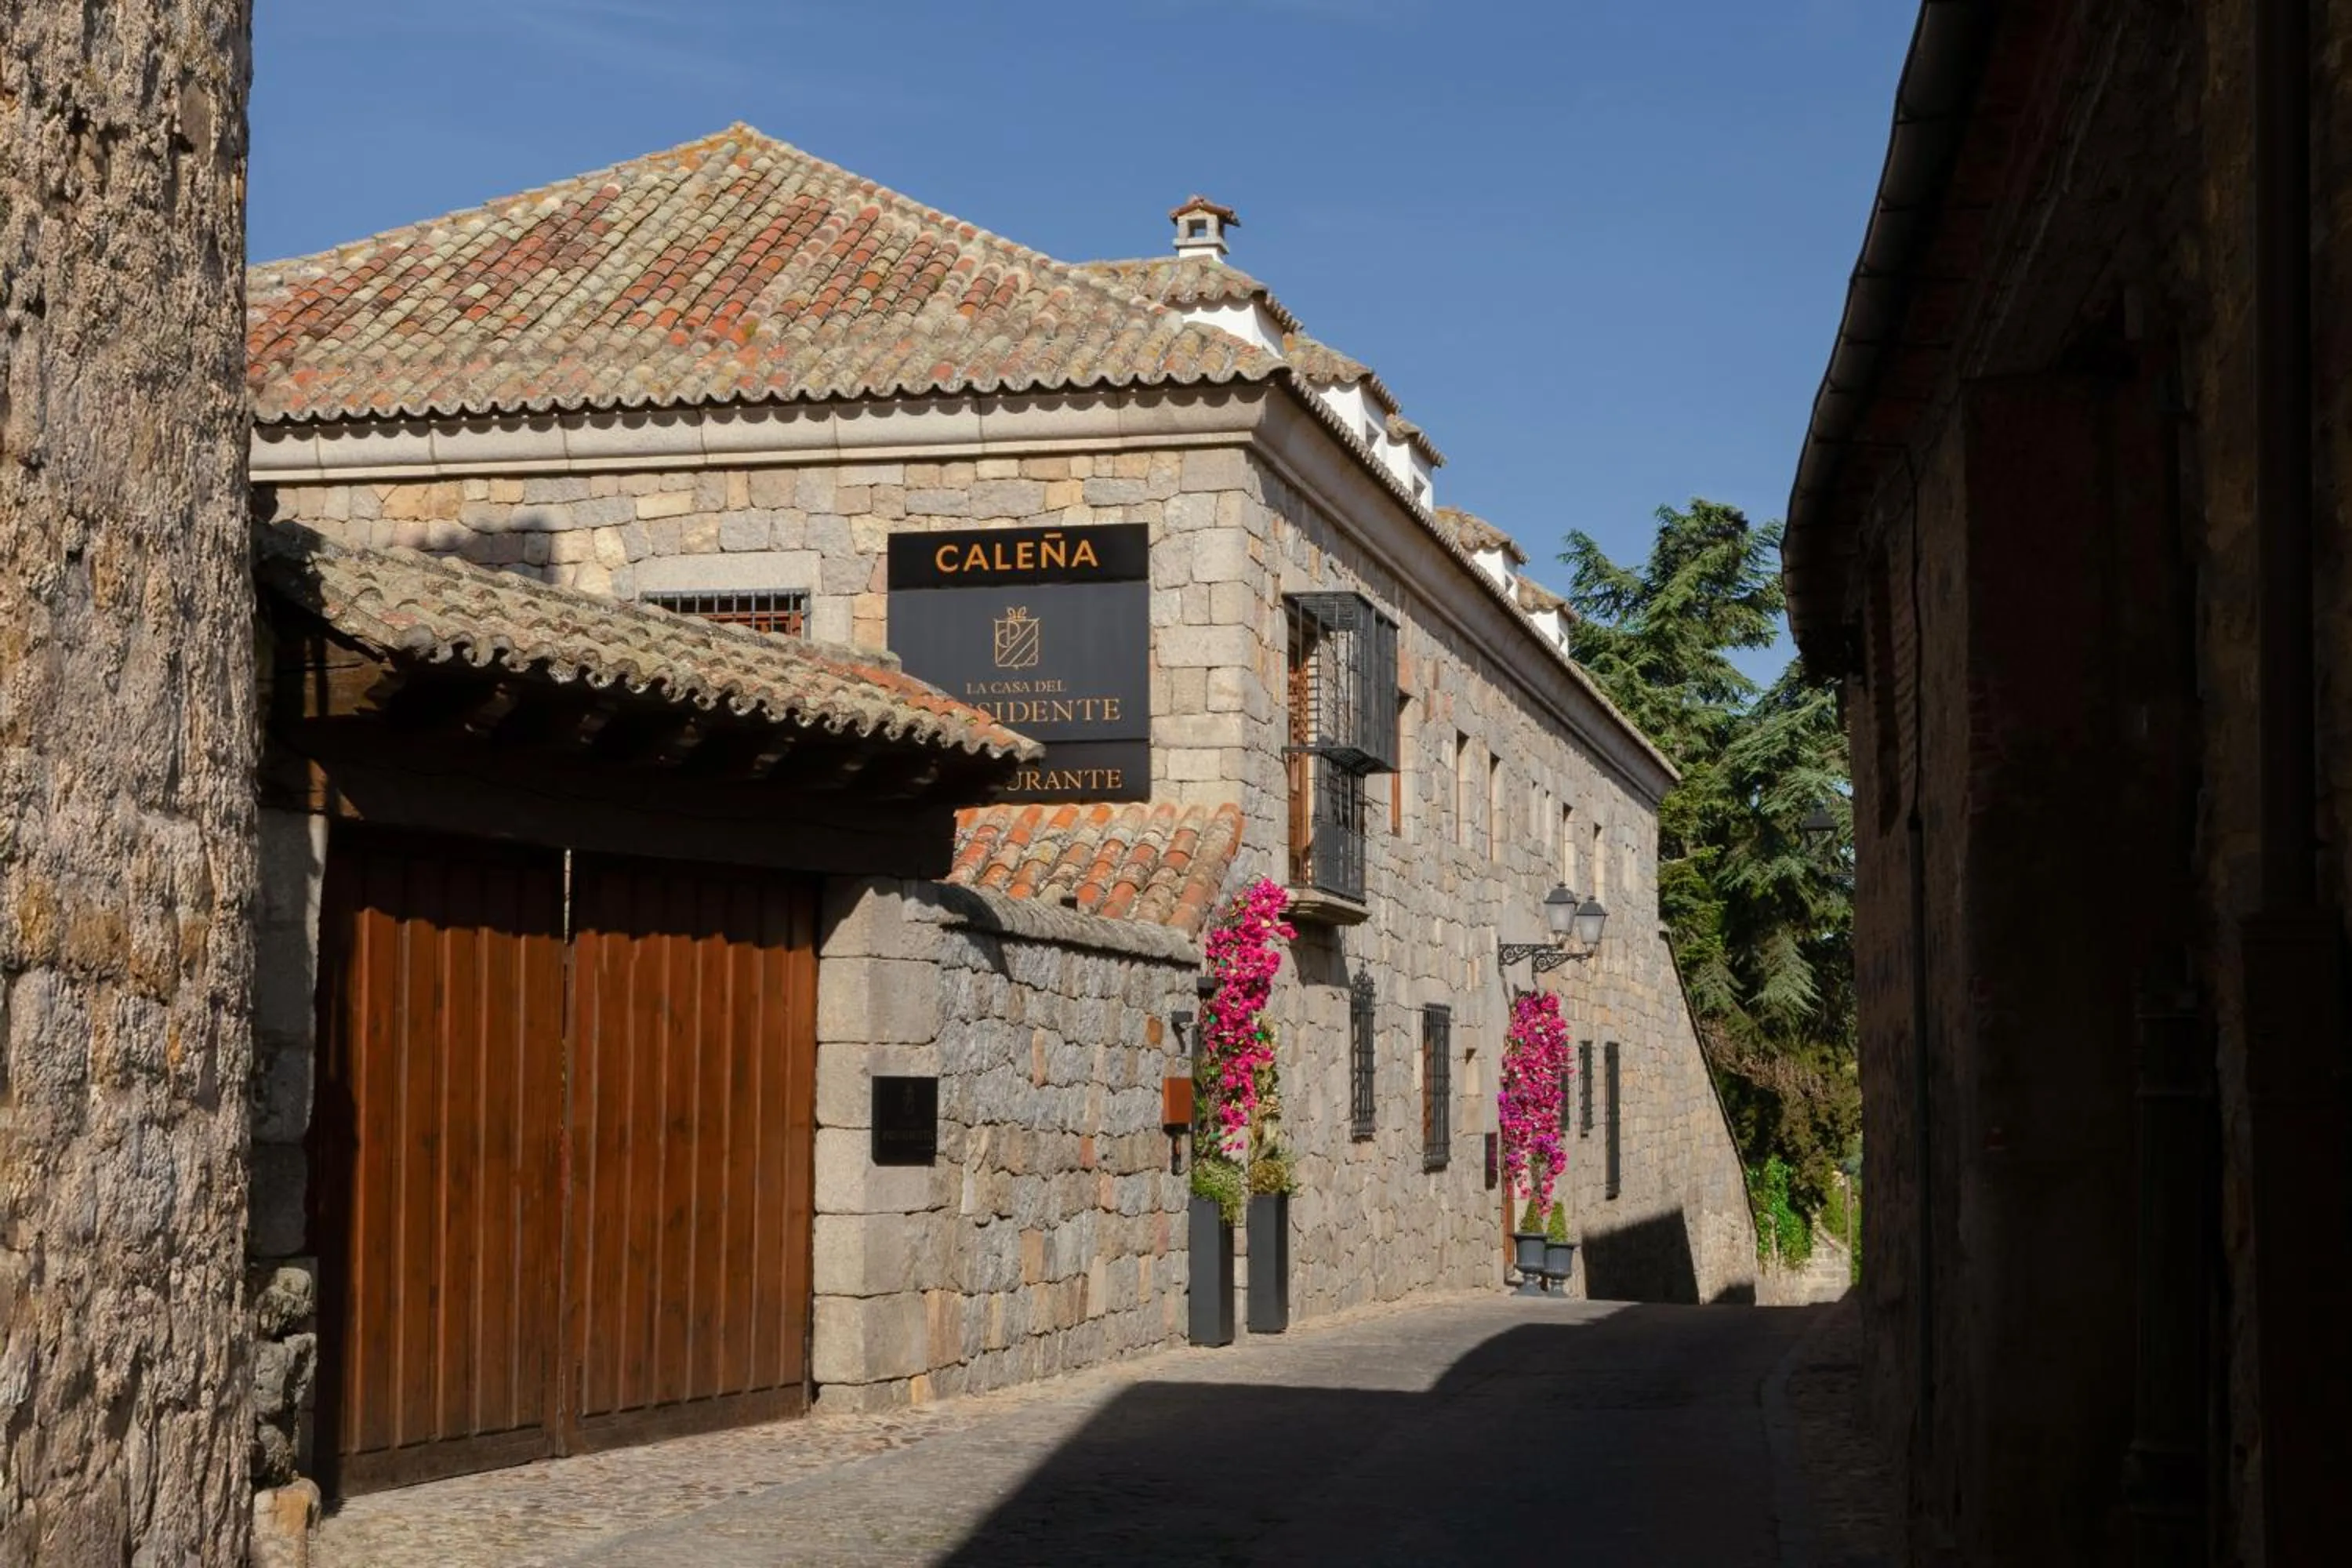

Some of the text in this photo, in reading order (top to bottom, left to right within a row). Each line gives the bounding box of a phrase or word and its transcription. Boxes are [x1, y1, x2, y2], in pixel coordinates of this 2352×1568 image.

[935, 533, 1098, 572] CALEÑA
[966, 678, 1066, 695] LA CASA DEL
[969, 699, 1121, 723] SIDENTE
